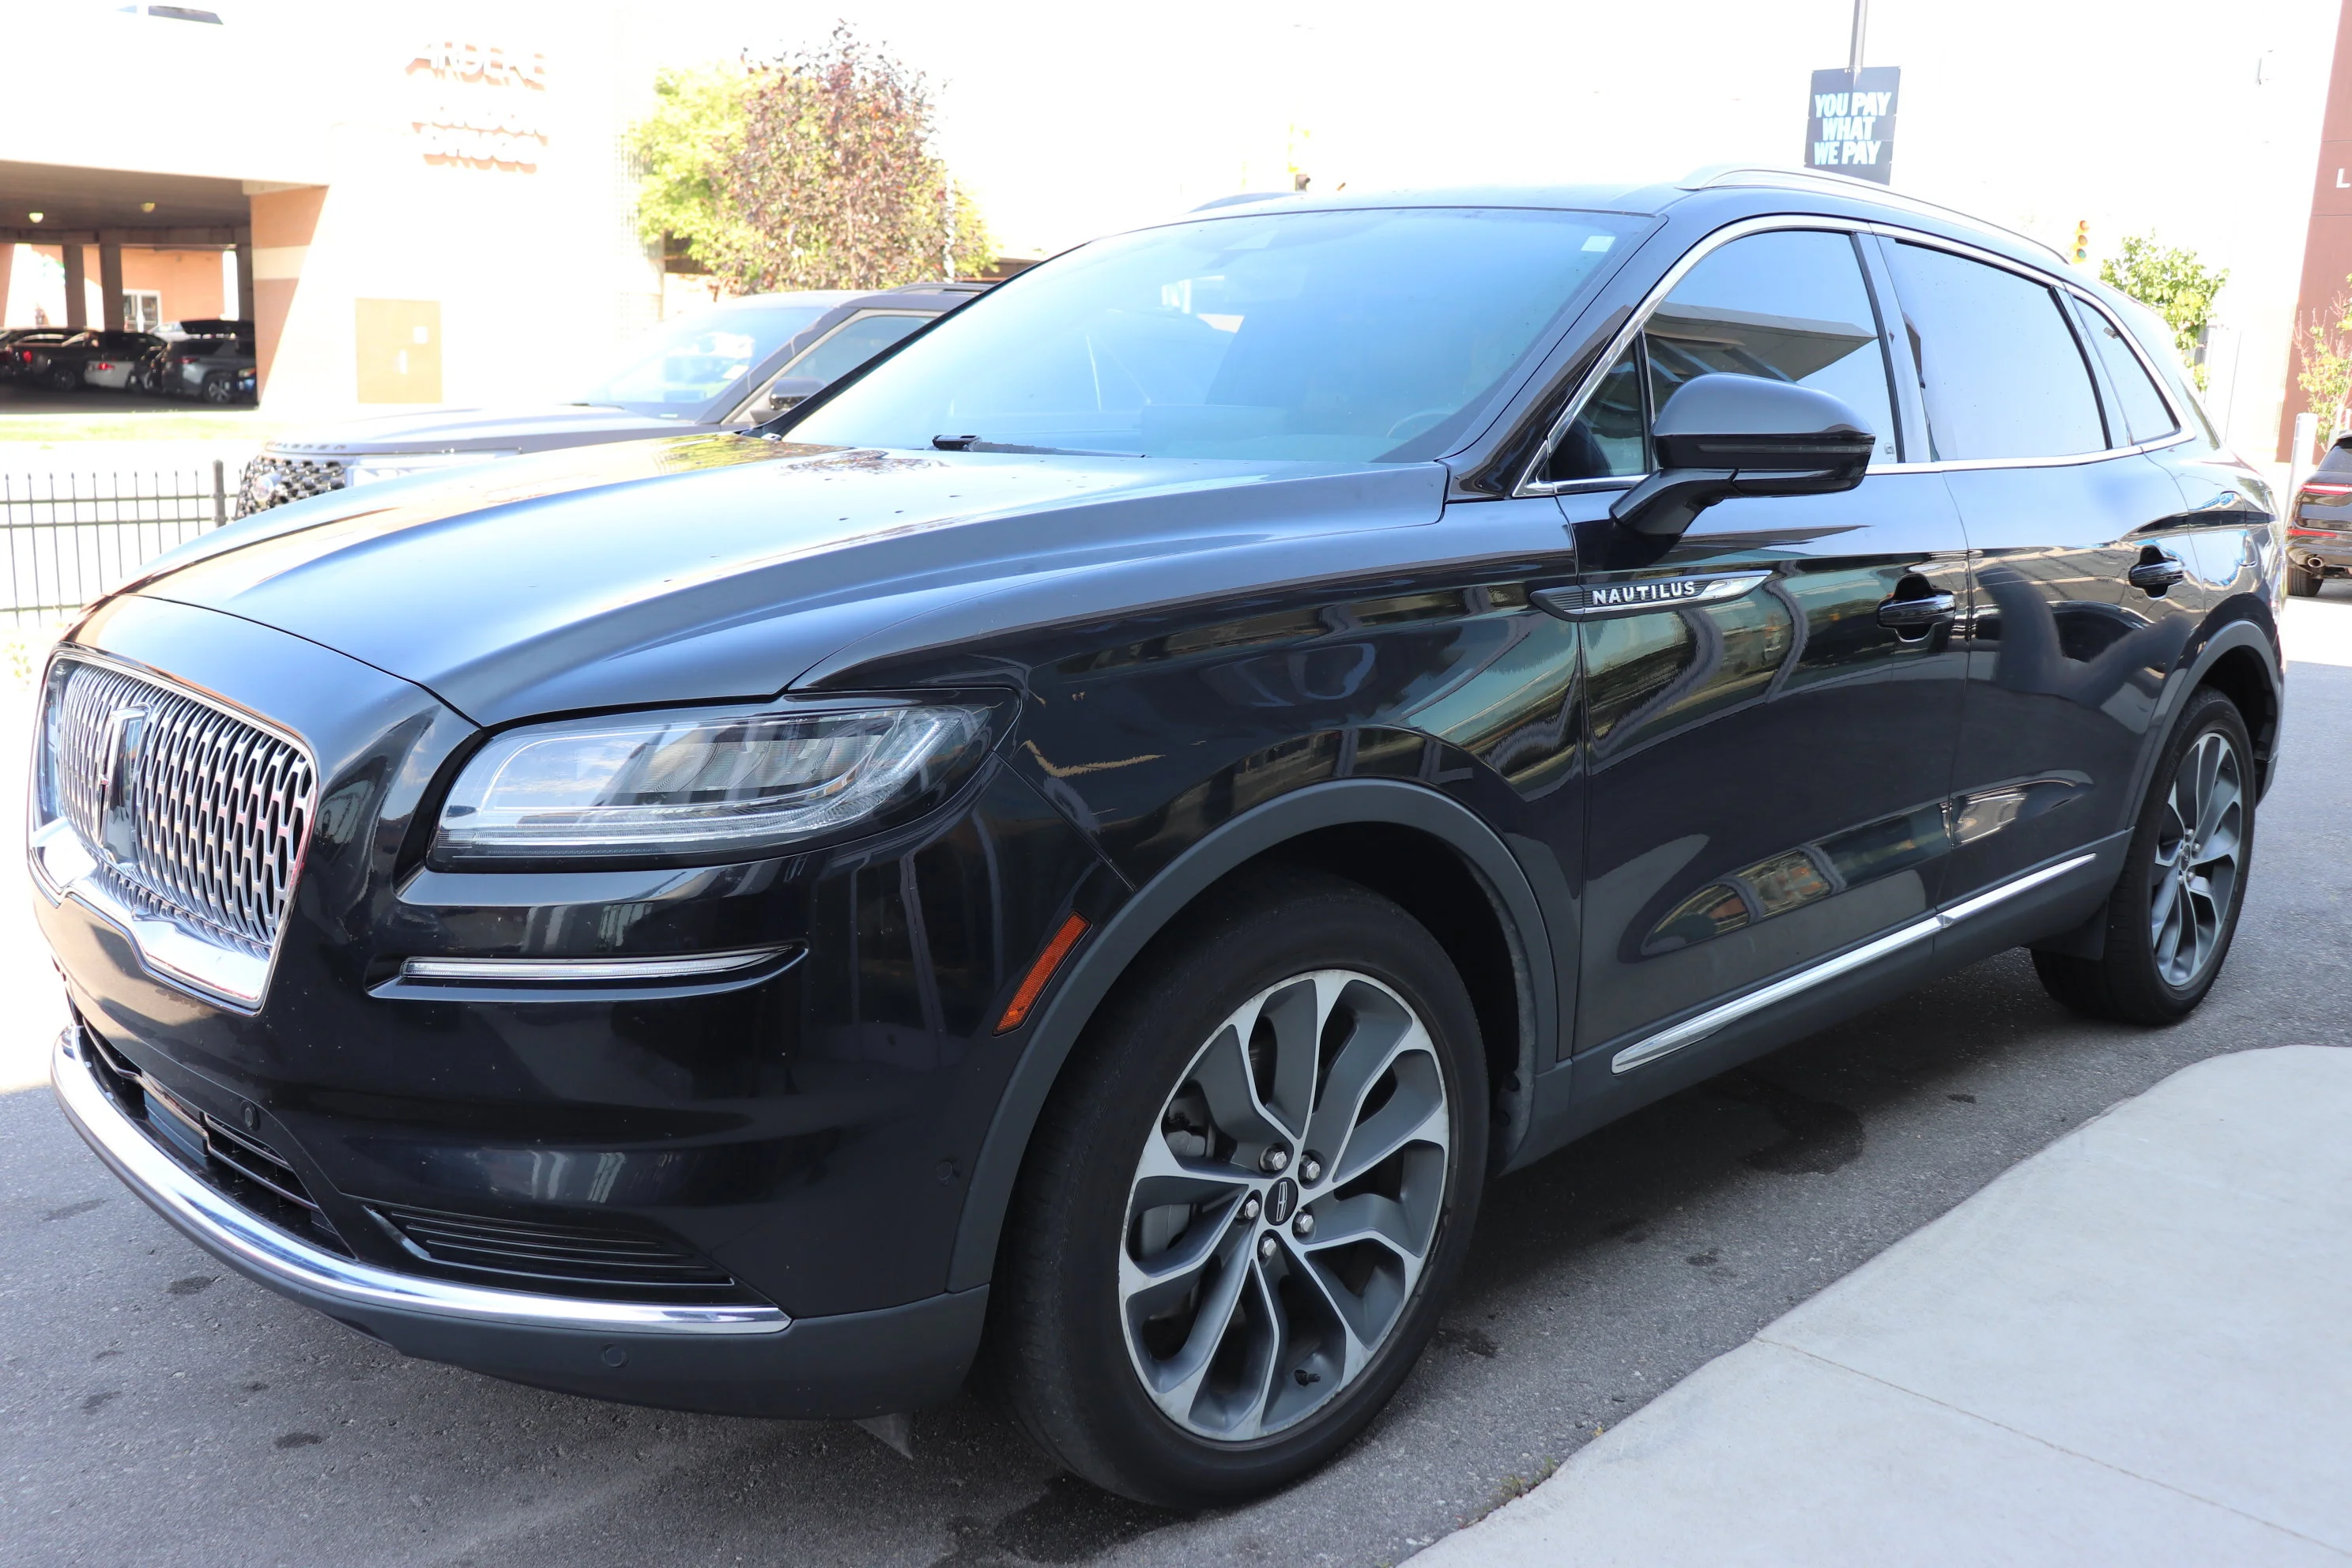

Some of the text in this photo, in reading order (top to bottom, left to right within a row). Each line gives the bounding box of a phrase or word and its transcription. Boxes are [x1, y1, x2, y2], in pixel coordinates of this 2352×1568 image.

[1815, 92, 1892, 118] YOU PAY
[1822, 116, 1876, 141] WHAT
[1814, 141, 1882, 165] WE PAY
[1592, 581, 1695, 605] NAUTILUS
